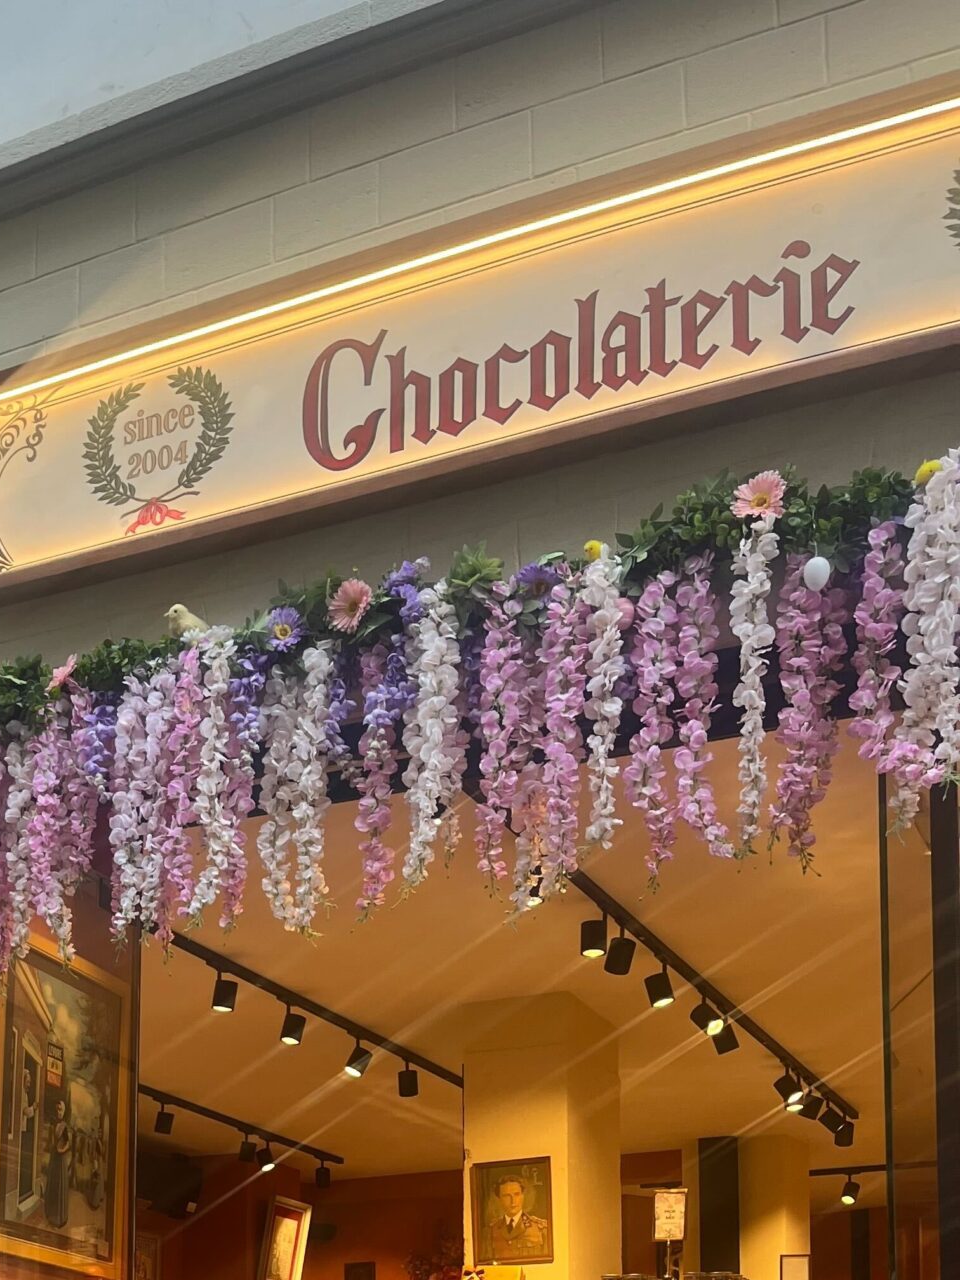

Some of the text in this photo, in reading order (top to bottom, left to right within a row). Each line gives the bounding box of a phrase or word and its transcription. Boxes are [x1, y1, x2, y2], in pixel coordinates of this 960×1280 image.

[302, 240, 861, 472] Chocolaterie
[123, 403, 195, 446] since
[126, 440, 189, 480] 2004
